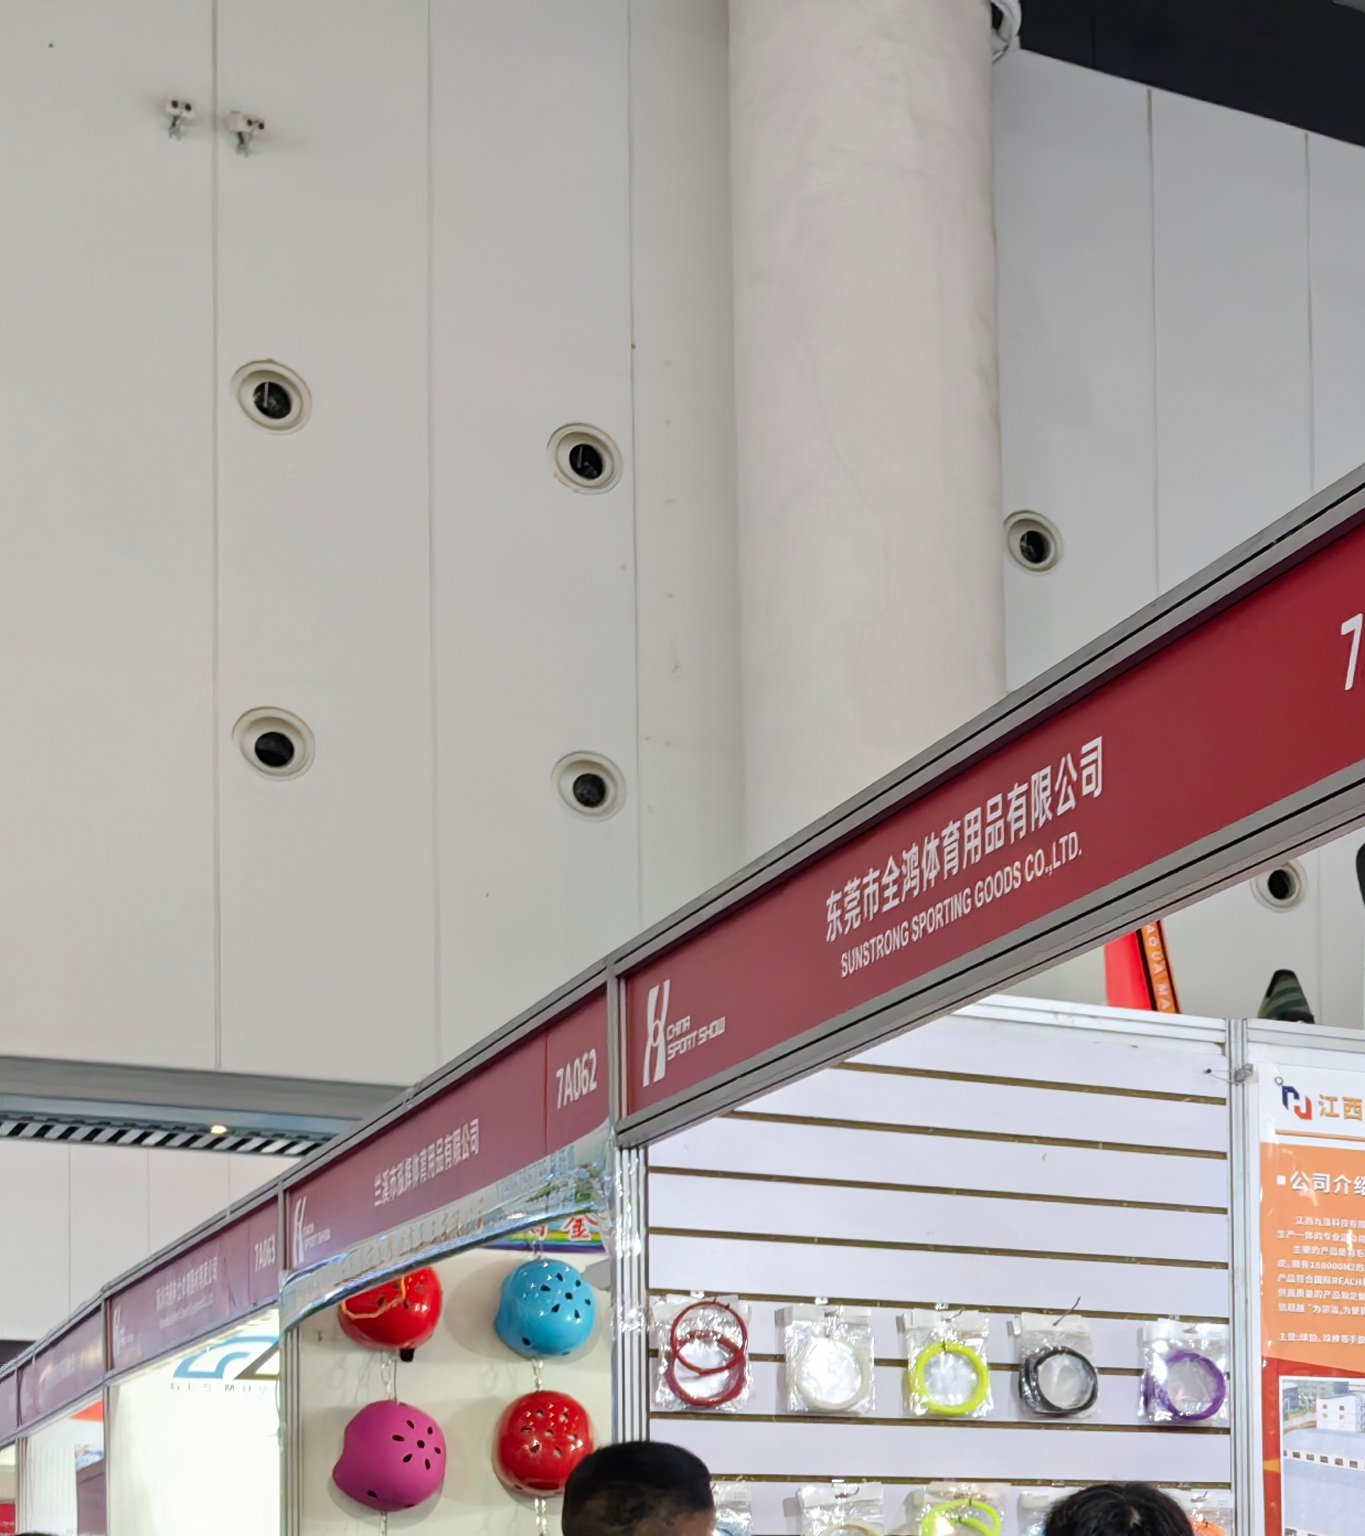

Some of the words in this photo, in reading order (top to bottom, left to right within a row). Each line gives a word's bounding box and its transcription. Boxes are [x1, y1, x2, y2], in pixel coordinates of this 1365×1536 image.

[826, 736, 1102, 942] 东莞市全鸿体育用品有限公司
[841, 922, 909, 978] SUNSTRONG
[911, 888, 972, 942] SPORTING
[975, 861, 1021, 908] GOODS
[1025, 832, 1082, 882] CO.,LTD.
[667, 1015, 690, 1040] CHINA
[667, 1031, 696, 1061] SPORT
[698, 1016, 725, 1046] SHOW
[555, 1048, 598, 1110] 7A062
